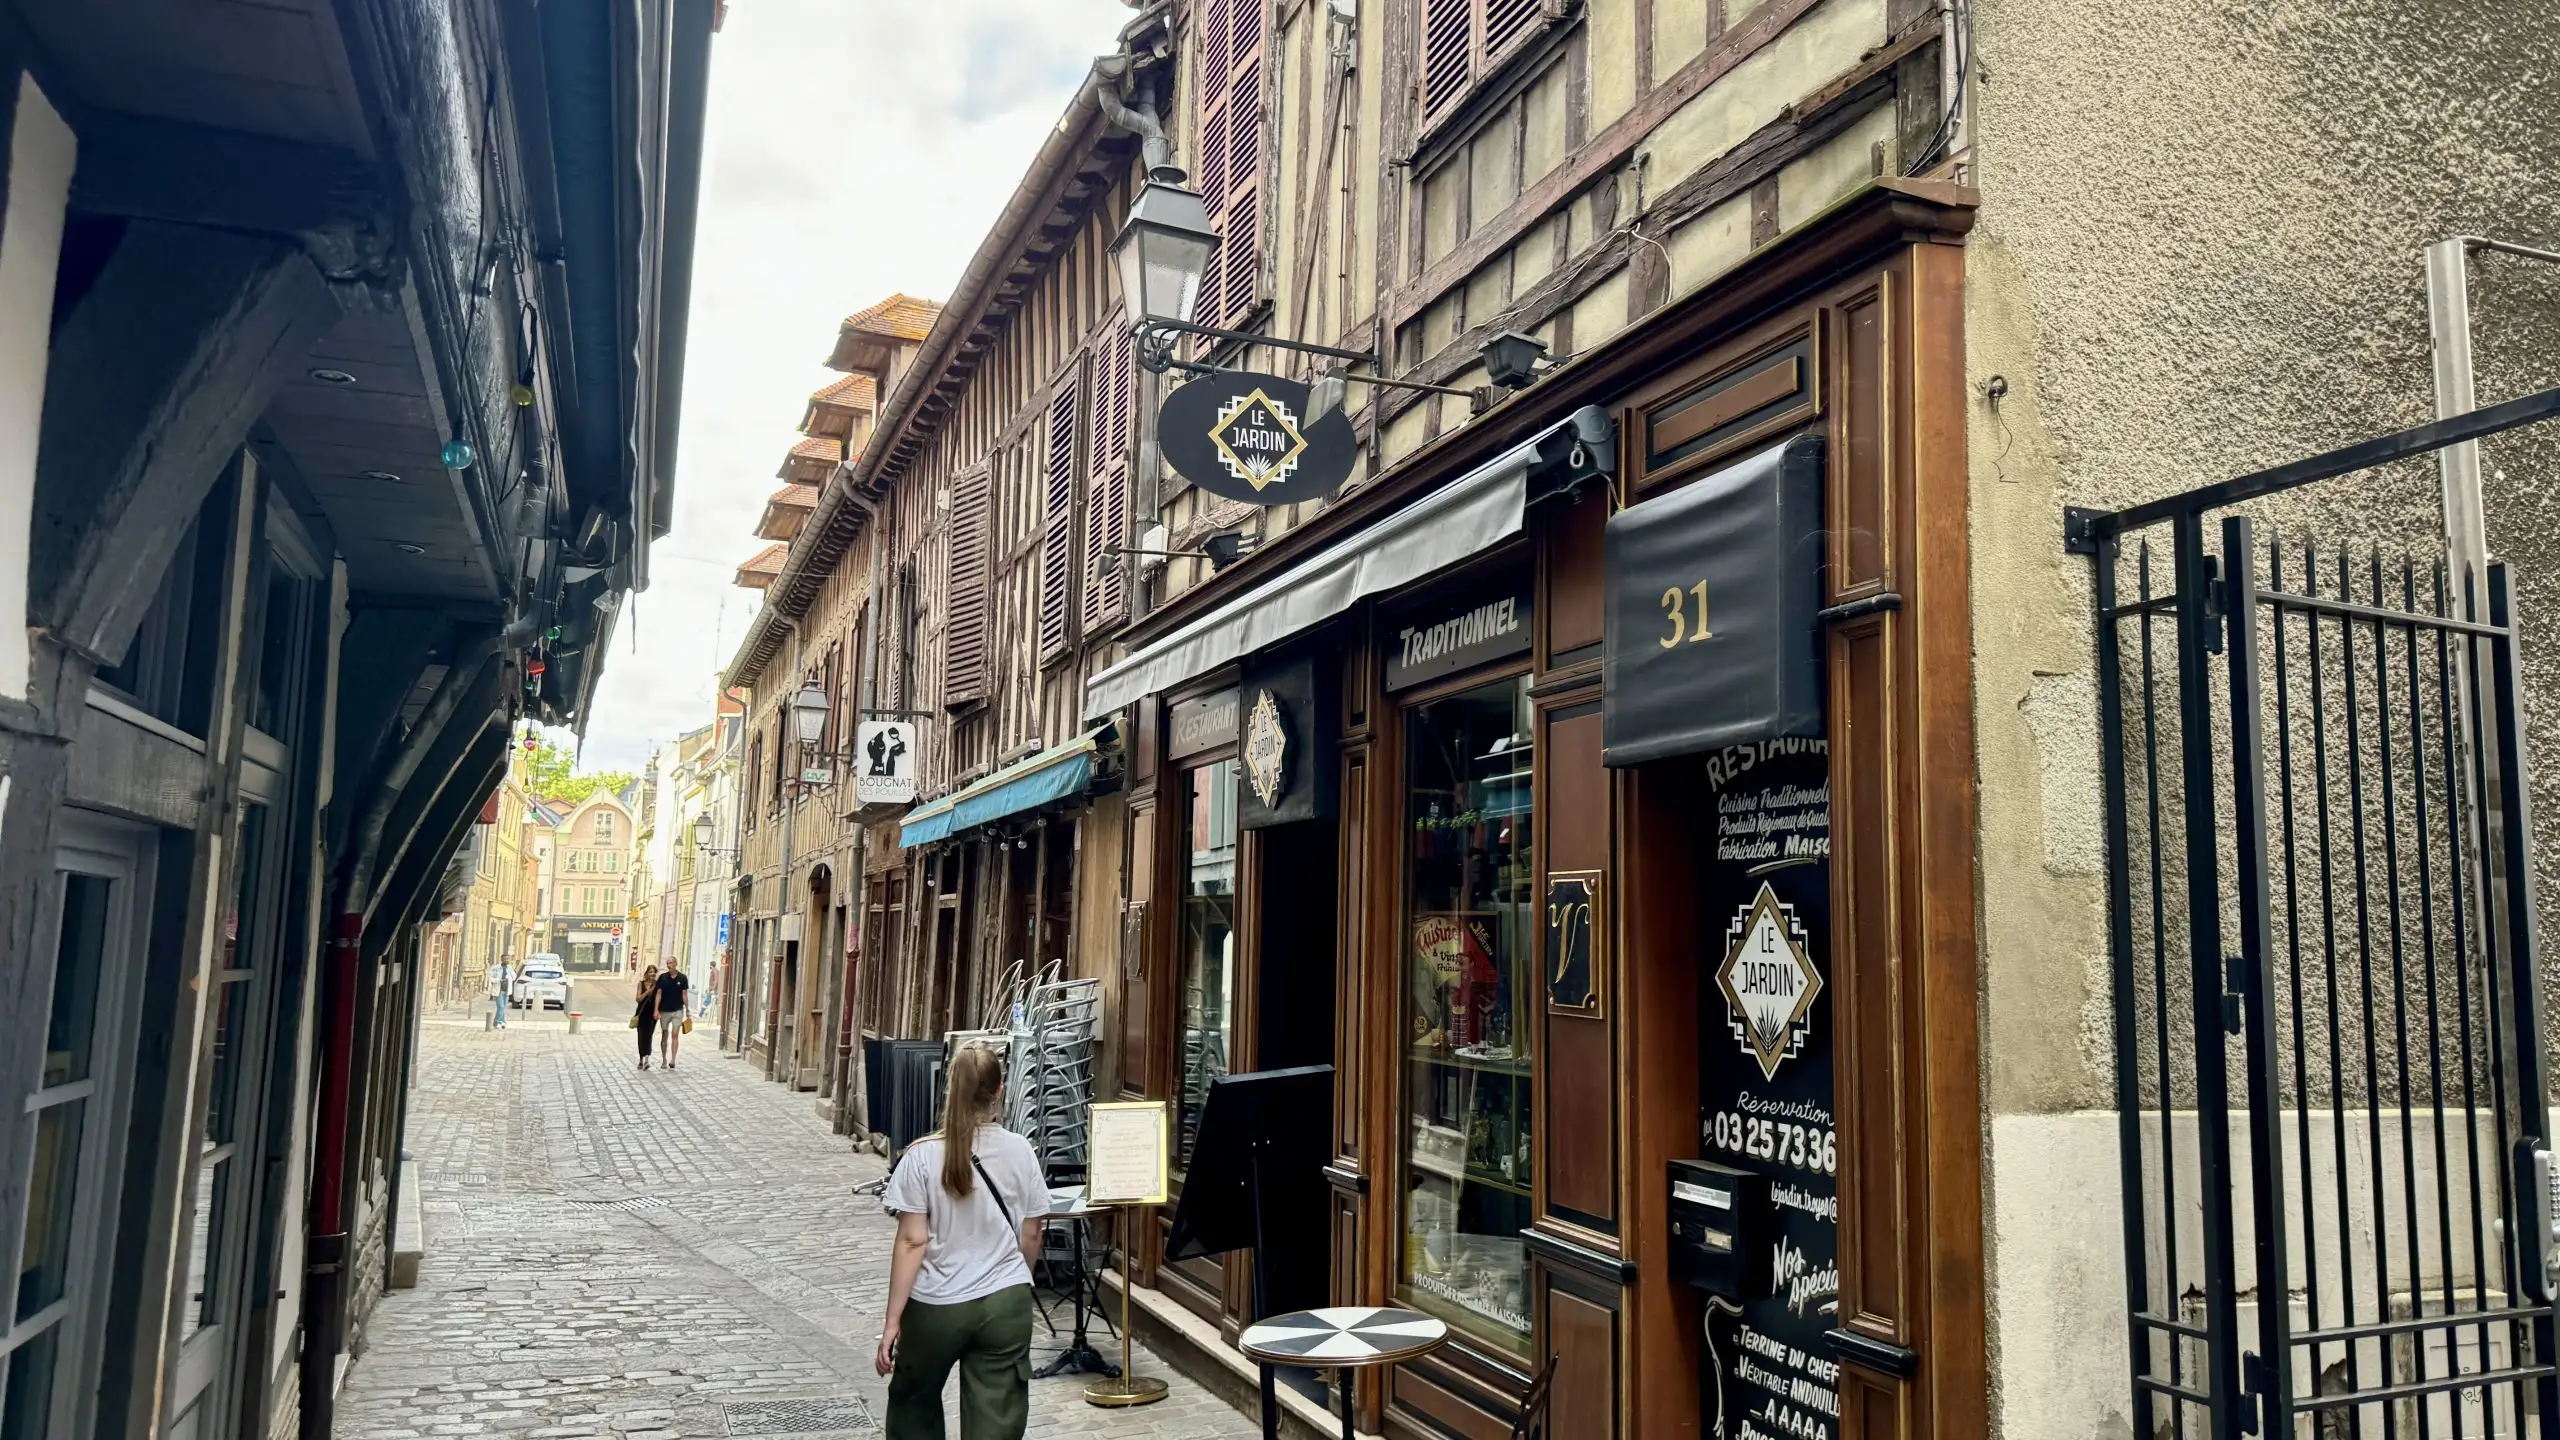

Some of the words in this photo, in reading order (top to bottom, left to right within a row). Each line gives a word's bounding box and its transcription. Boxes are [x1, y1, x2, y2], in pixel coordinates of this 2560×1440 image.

[1252, 409, 1265, 426] LE
[1232, 427, 1286, 452] JARDIN
[1660, 579, 1713, 649] 31
[1400, 597, 1518, 669] TRADITIONNEL
[1176, 701, 1237, 746] RESTAURANT
[1255, 735, 1276, 760] JARDIN
[860, 777, 913, 788] BOUGNAT
[1718, 792, 1758, 814] Cuisine
[1760, 776, 1829, 808] Traditionnel
[1718, 813, 1757, 836] Produits
[1797, 809, 1808, 829] de
[1807, 804, 1829, 831] Qual
[1718, 837, 1781, 860] Fabrication
[1761, 926, 1775, 953] LE
[1741, 961, 1794, 997] JARDIN
[1737, 1090, 1835, 1126] Réservation
[1715, 1111, 1743, 1152] 03
[1746, 1117, 1774, 1160] 25
[1777, 1122, 1805, 1166] 73
[1807, 1127, 1836, 1173] 36
[1772, 1234, 1806, 1295] Nos
[1740, 1324, 1787, 1363] TERRINE
[1788, 1348, 1806, 1369] DU
[1807, 1356, 1840, 1383] CHEF
[1739, 1354, 1790, 1395] VÉRITABLE
